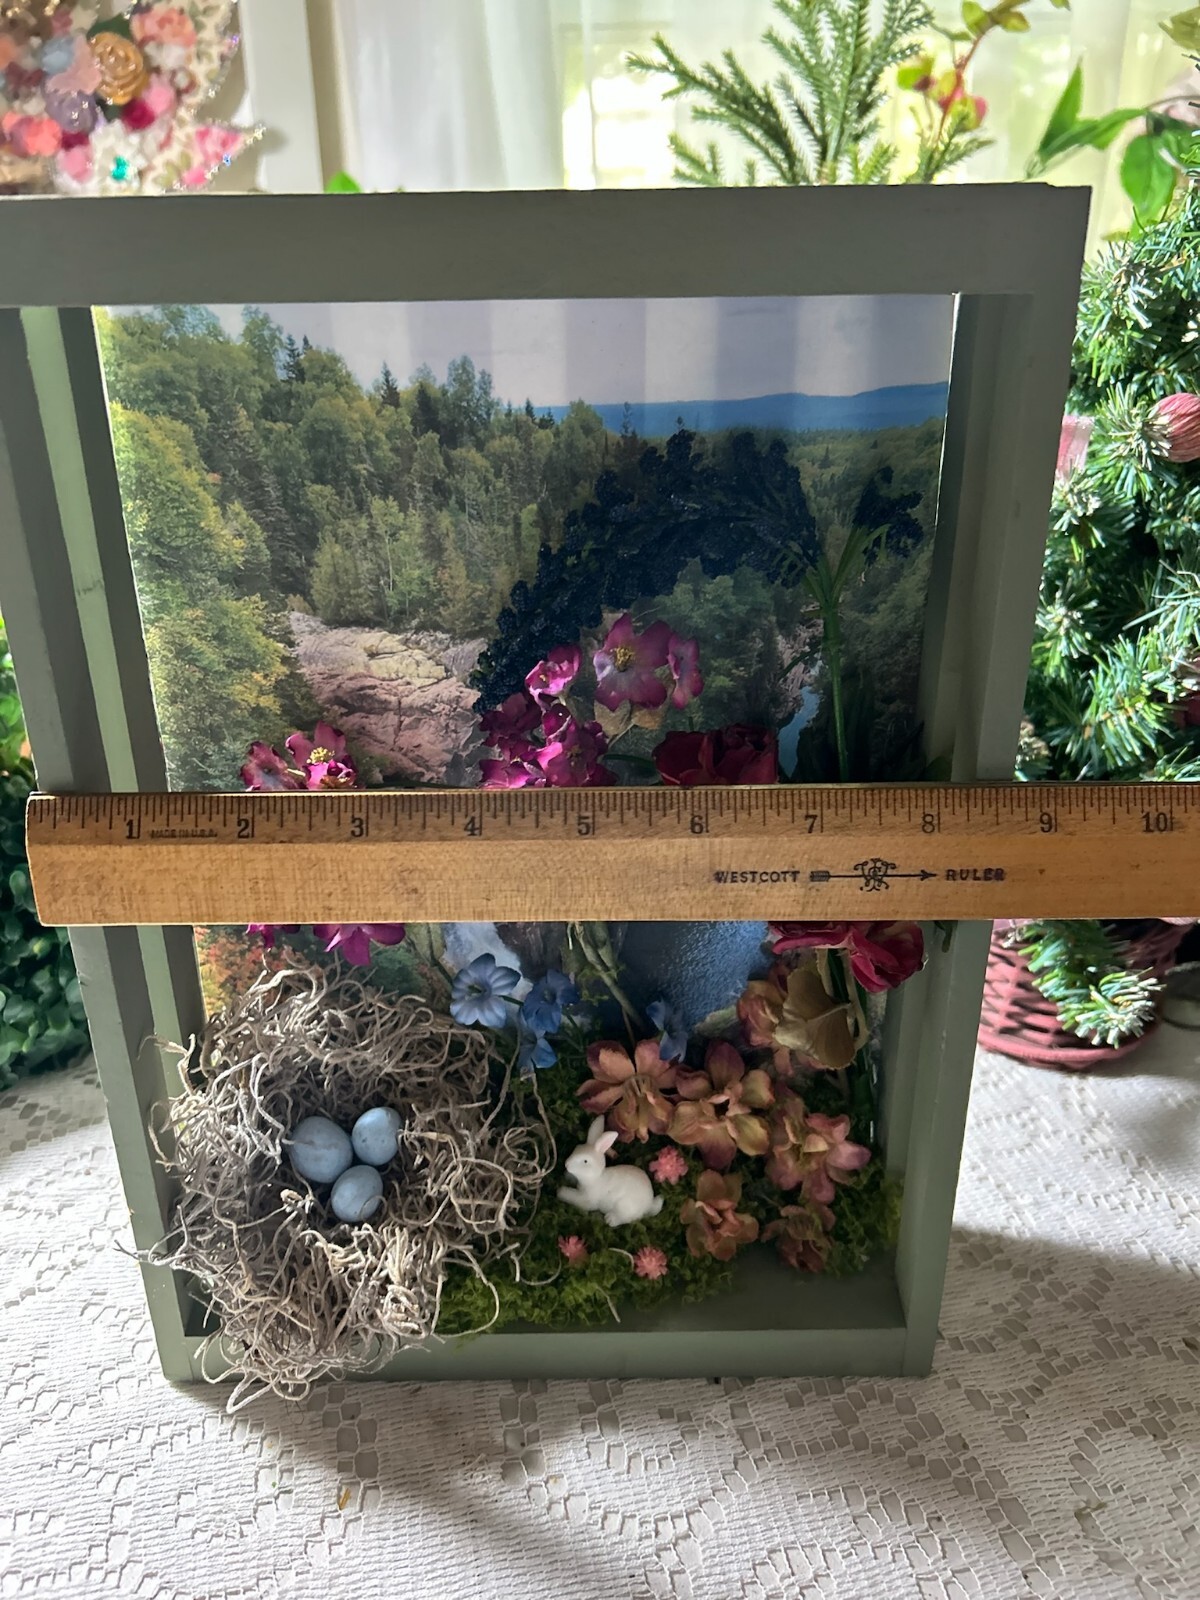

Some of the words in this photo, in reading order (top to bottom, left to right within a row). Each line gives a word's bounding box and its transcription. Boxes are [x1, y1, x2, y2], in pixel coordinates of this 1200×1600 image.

[125, 818, 138, 839] 1
[236, 818, 250, 839] 2
[351, 816, 364, 838] 3
[463, 815, 480, 837] 4
[577, 814, 591, 836] 5
[689, 814, 704, 834] 6
[804, 814, 818, 834] 7
[921, 813, 935, 834] 8
[1039, 811, 1053, 833] 9
[1141, 811, 1169, 833] 10
[714, 869, 800, 884] WESTCOTT
[945, 867, 1006, 882] RULER
